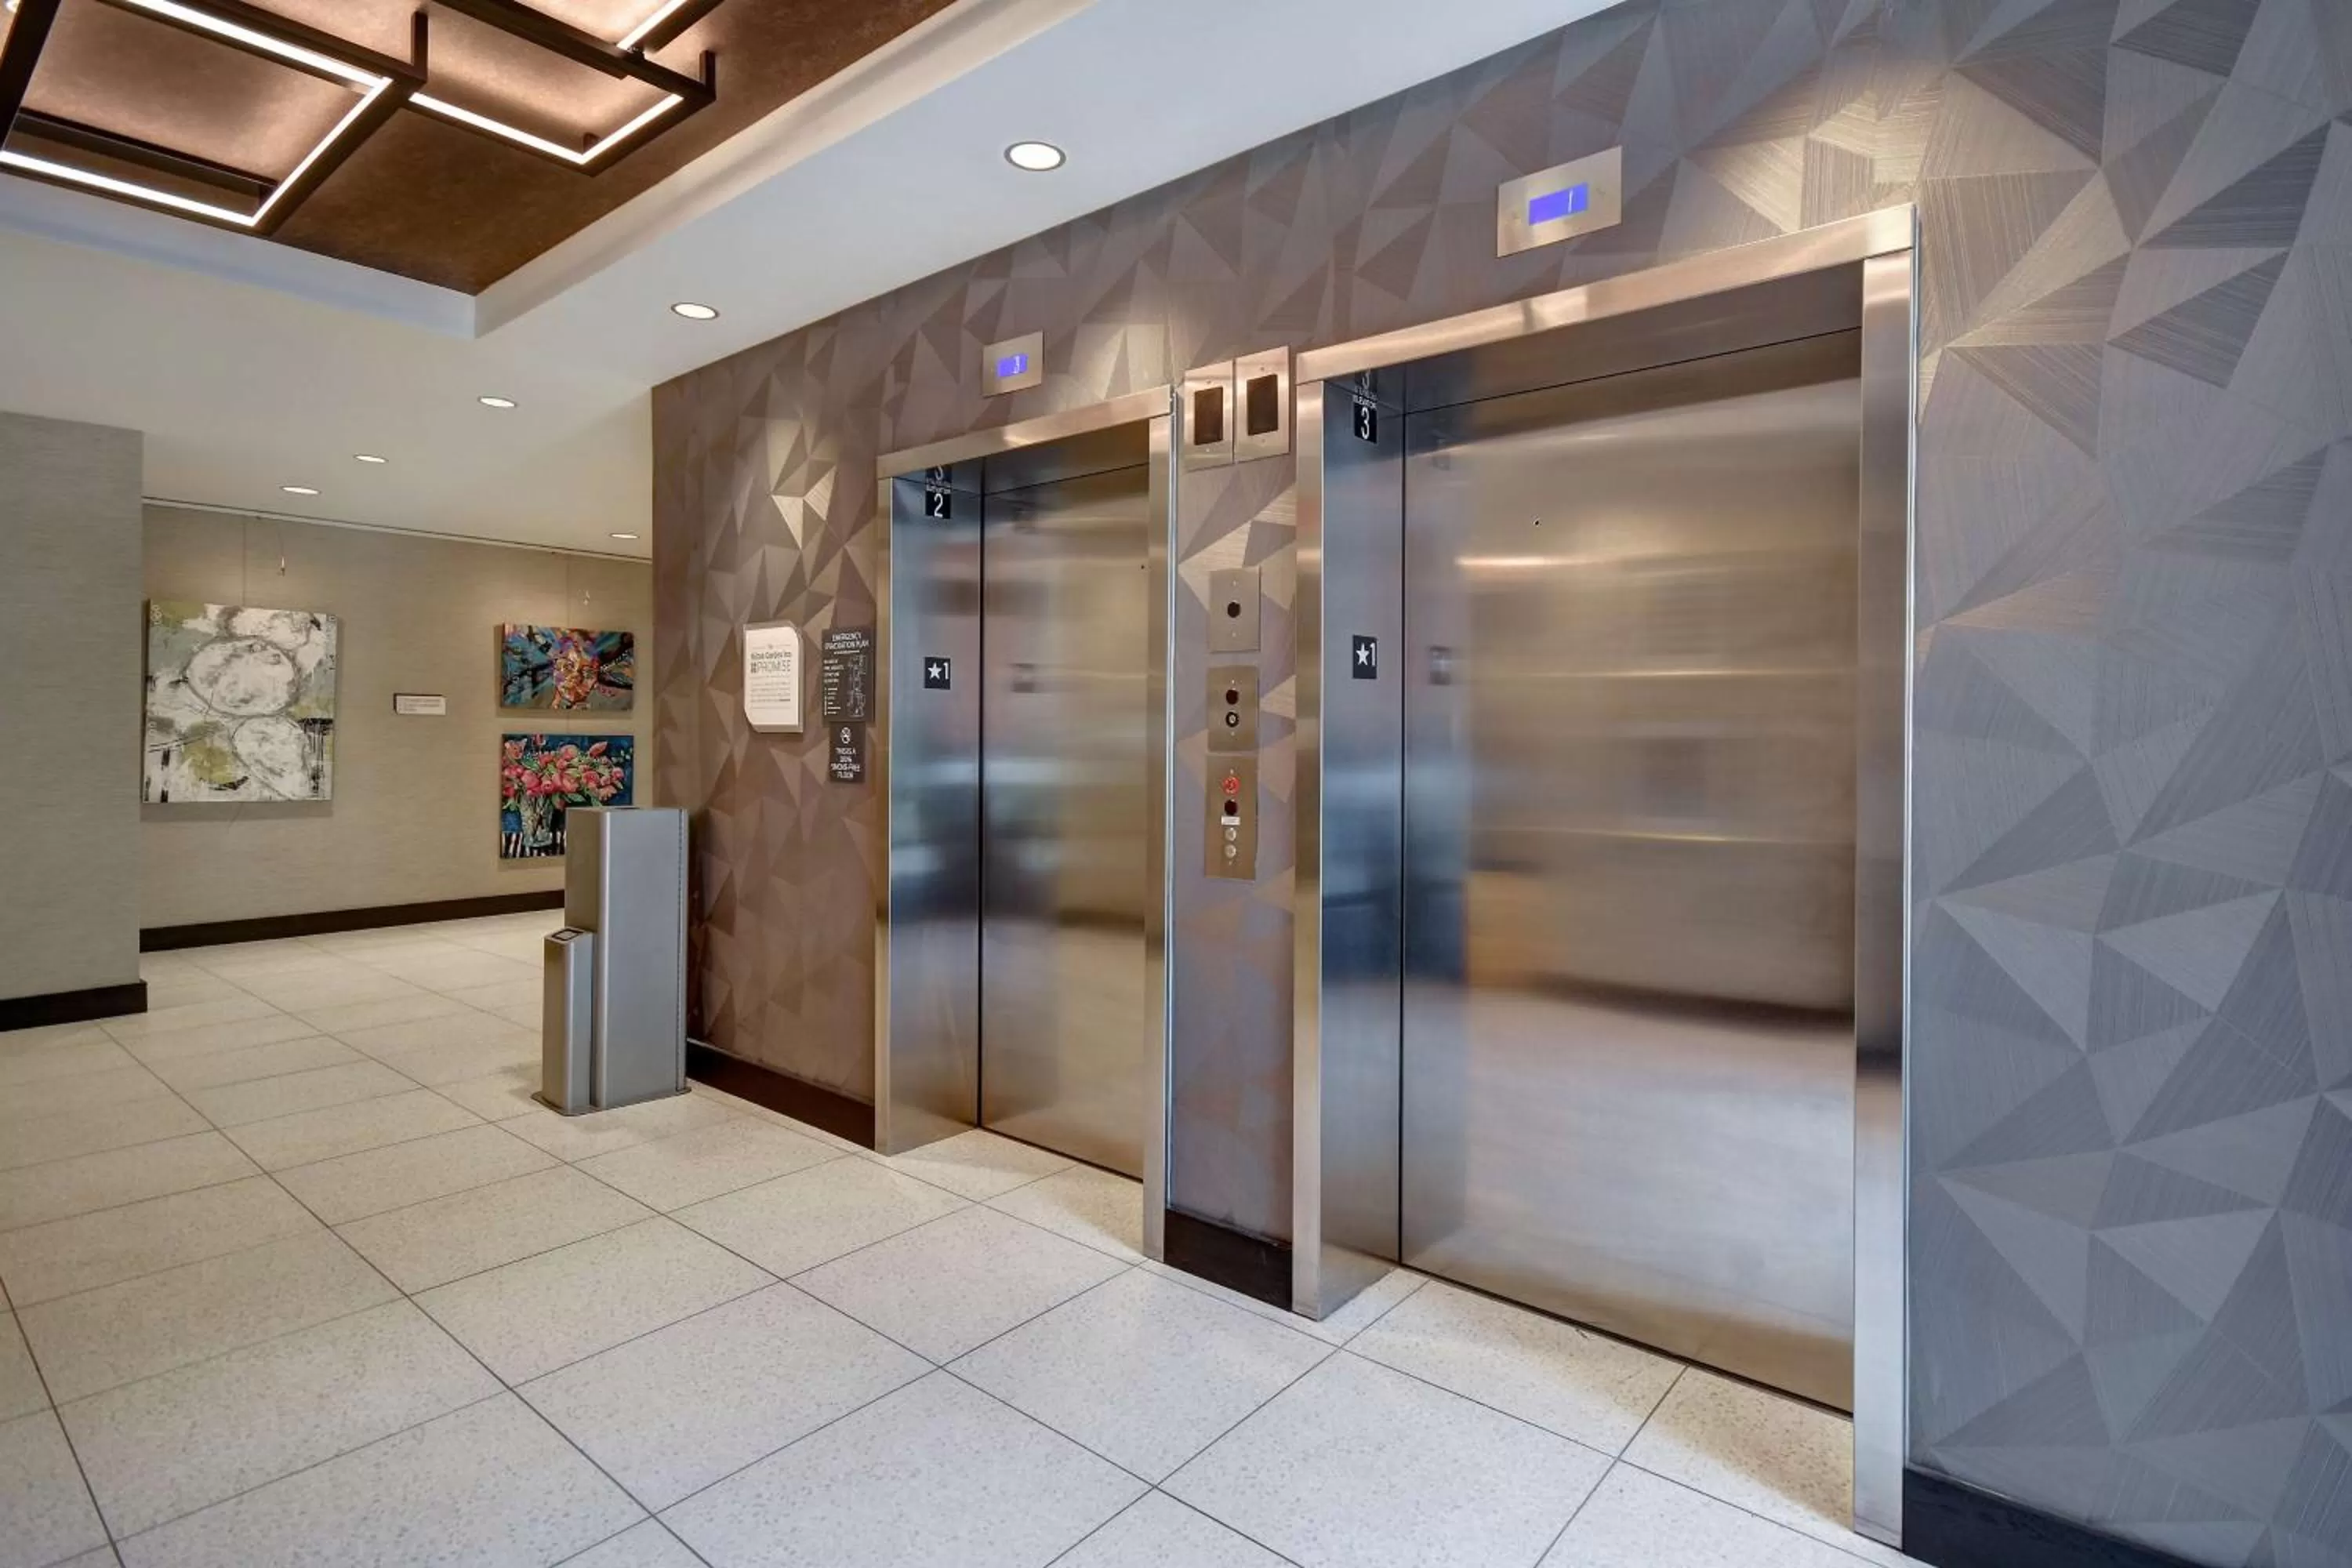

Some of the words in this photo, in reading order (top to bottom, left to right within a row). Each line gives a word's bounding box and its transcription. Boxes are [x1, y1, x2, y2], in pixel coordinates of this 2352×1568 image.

[1361, 407, 1370, 439] 3
[934, 492, 944, 517] 2
[1370, 642, 1376, 666] 1
[943, 662, 949, 680] 1
